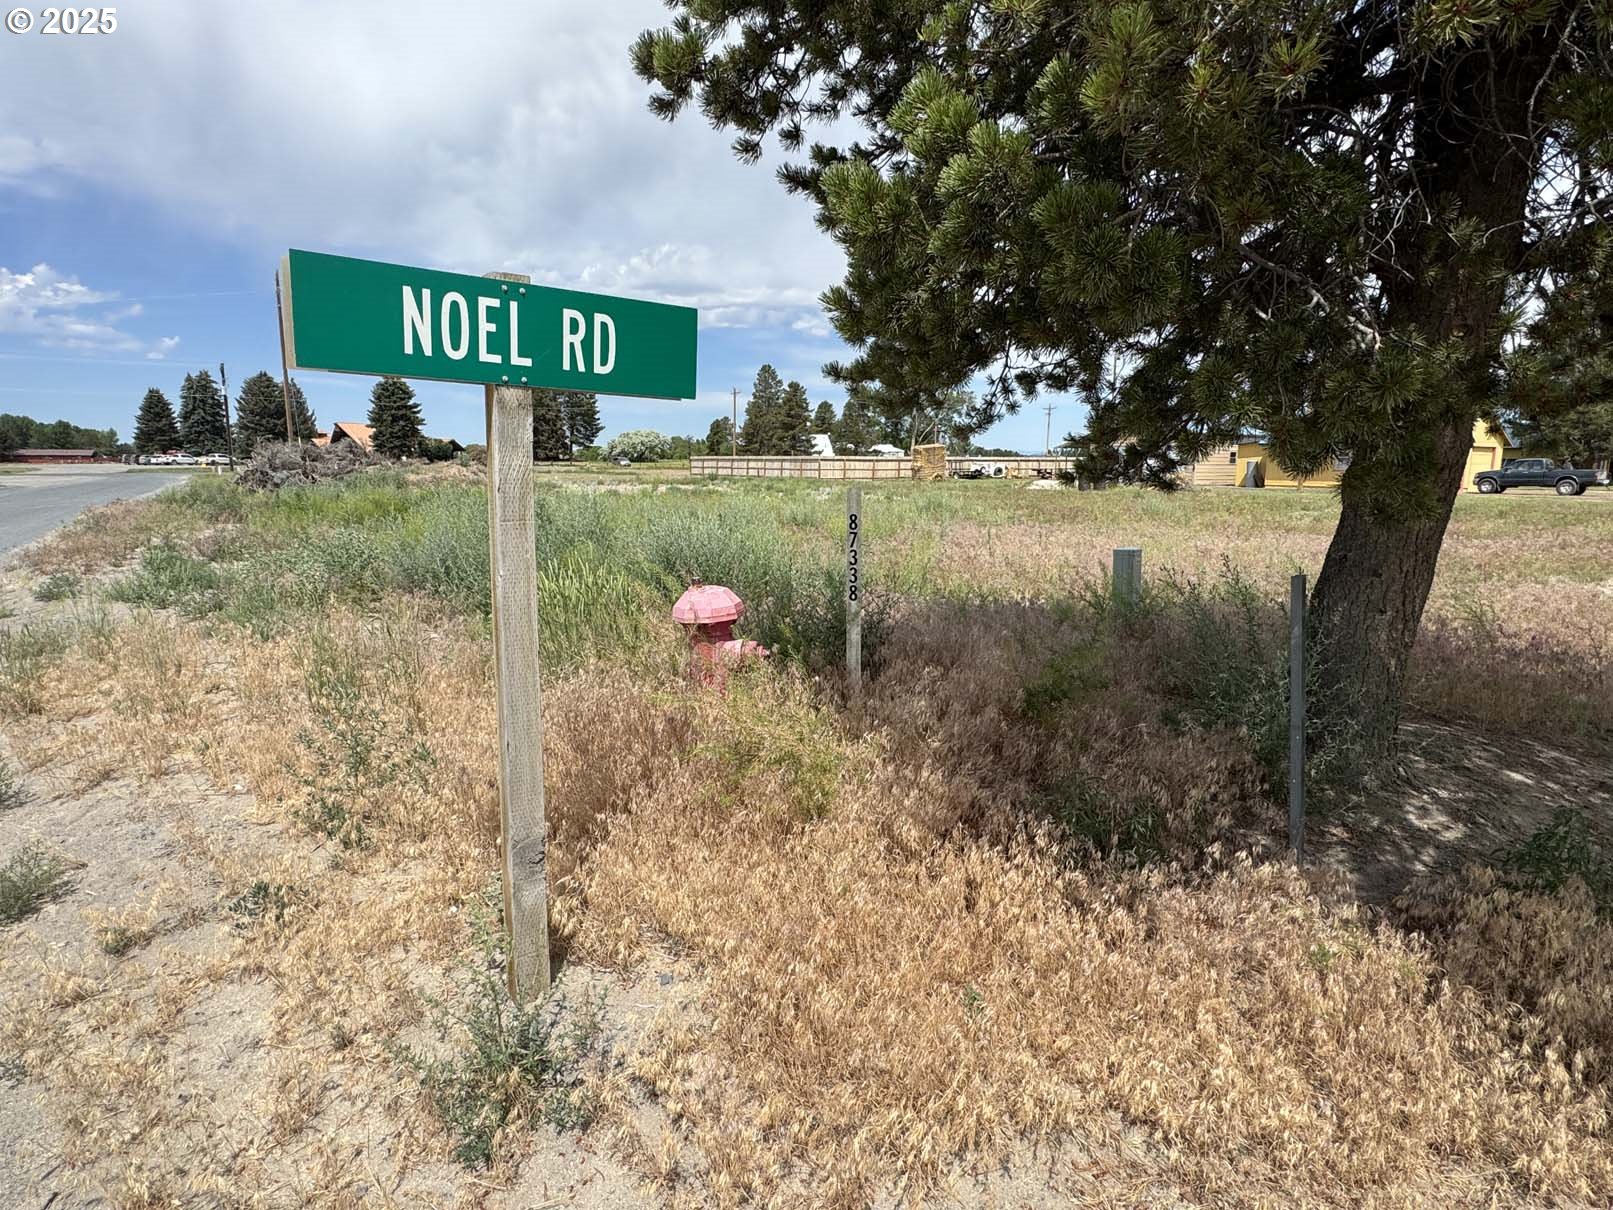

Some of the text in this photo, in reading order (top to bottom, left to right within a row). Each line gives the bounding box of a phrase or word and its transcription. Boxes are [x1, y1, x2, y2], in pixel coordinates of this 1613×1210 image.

[402, 285, 616, 375] NOEL RD
[849, 513, 858, 601] 87338
